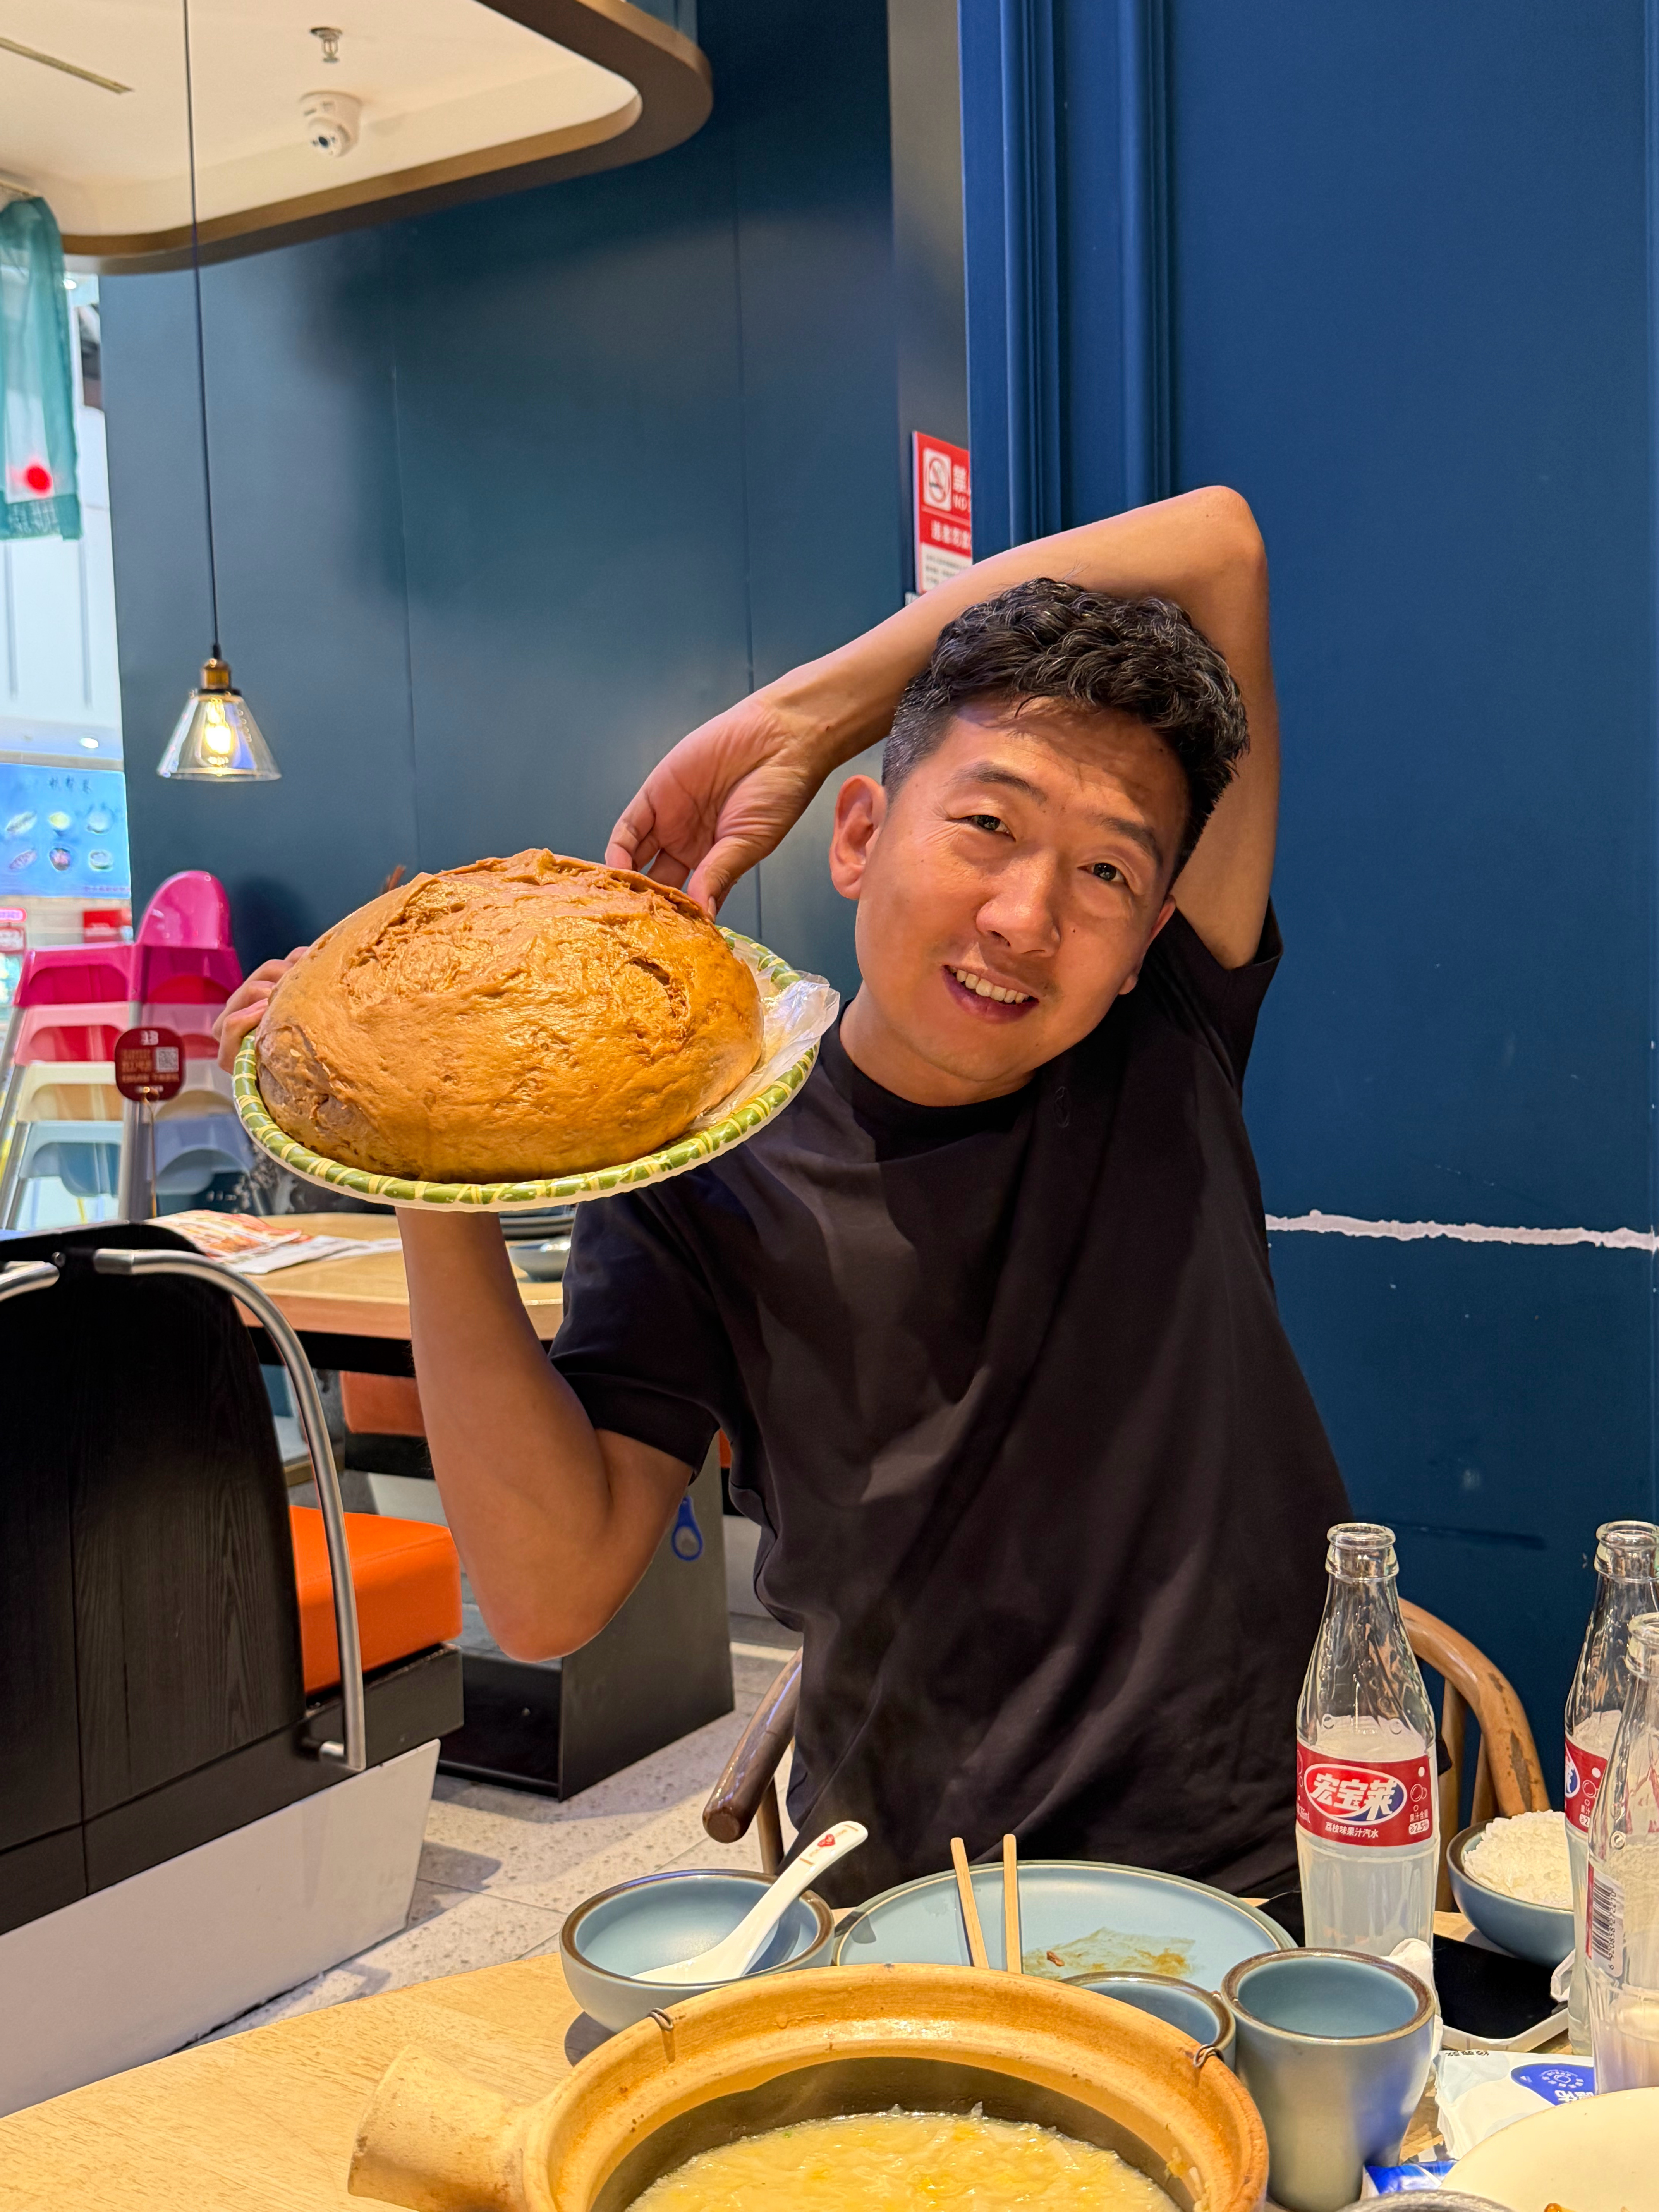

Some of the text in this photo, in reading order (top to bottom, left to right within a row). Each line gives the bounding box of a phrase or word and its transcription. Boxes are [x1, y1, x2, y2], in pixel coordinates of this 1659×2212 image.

[1309, 1773, 1397, 1820] 宏宝莱
[1325, 1821, 1379, 1839] 荔枝味果汁汽水
